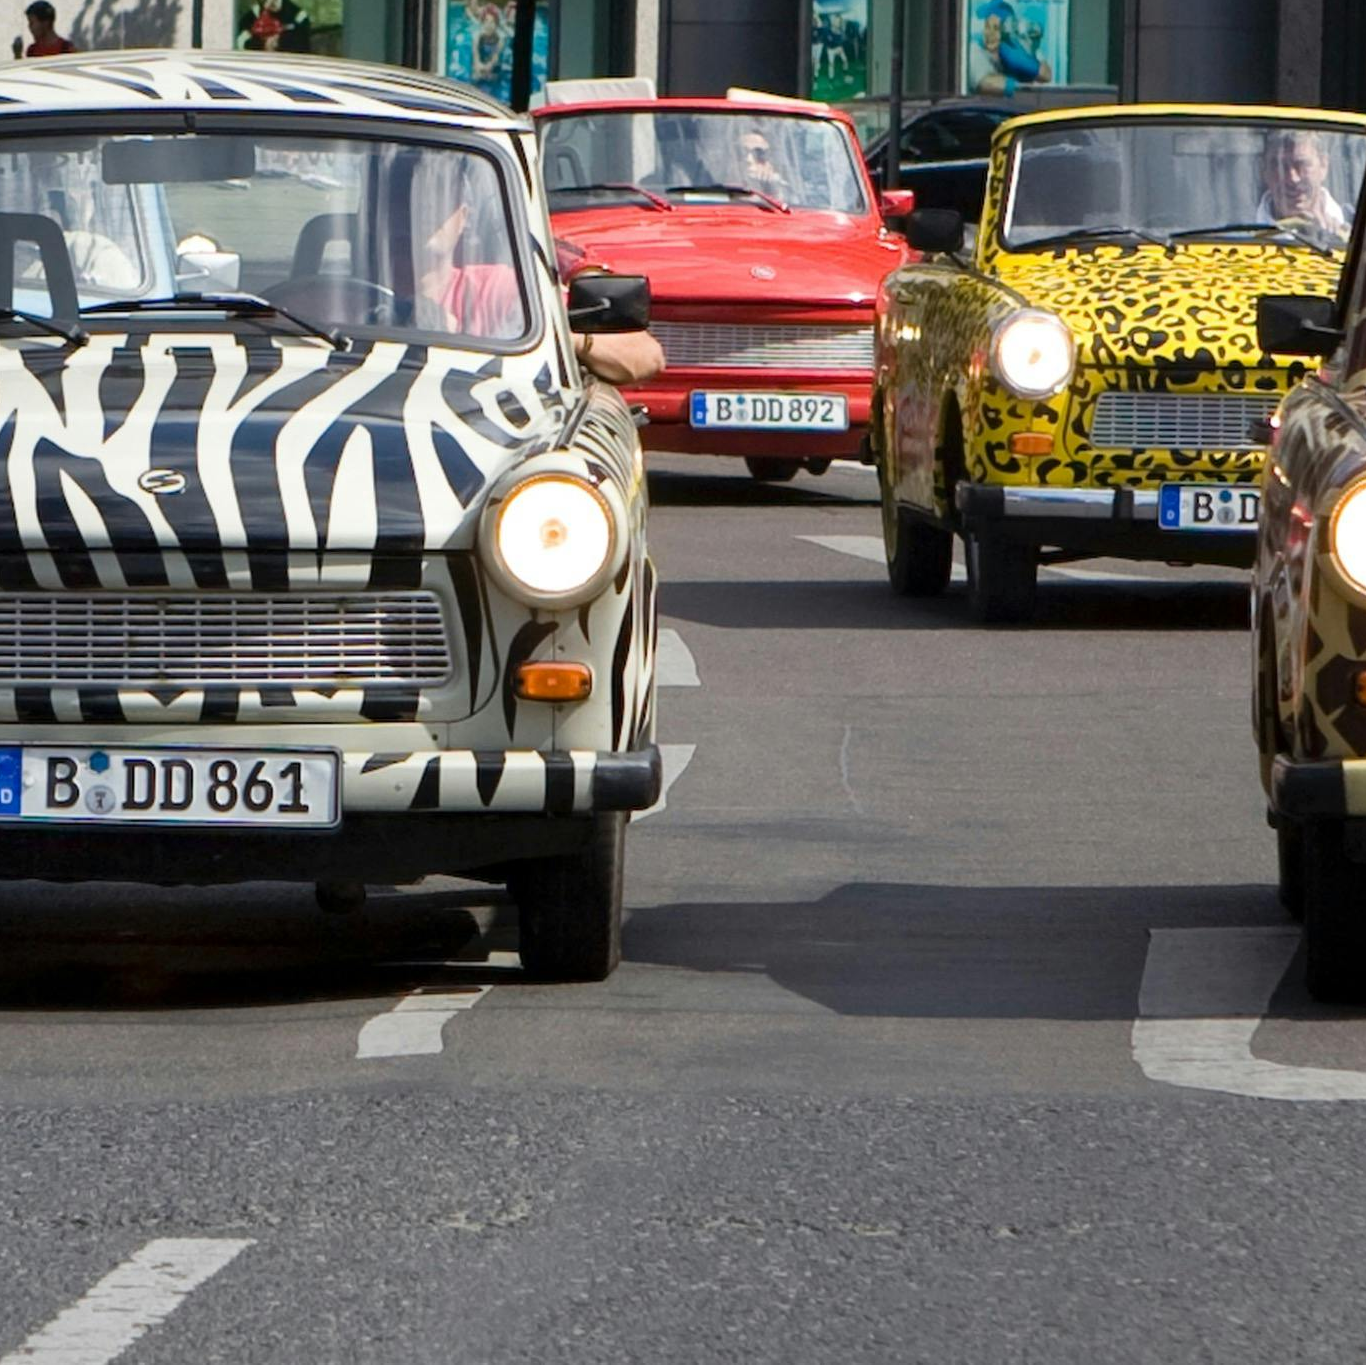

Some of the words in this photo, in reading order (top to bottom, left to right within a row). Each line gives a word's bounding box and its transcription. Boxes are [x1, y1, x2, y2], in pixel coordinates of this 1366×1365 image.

[716, 397, 732, 421] B
[751, 398, 783, 422] DD
[788, 399, 834, 423] 892
[1193, 491, 1214, 523] B
[0, 789, 12, 803] D
[46, 756, 81, 809] B
[121, 758, 194, 811] DD
[206, 759, 310, 813] 861
